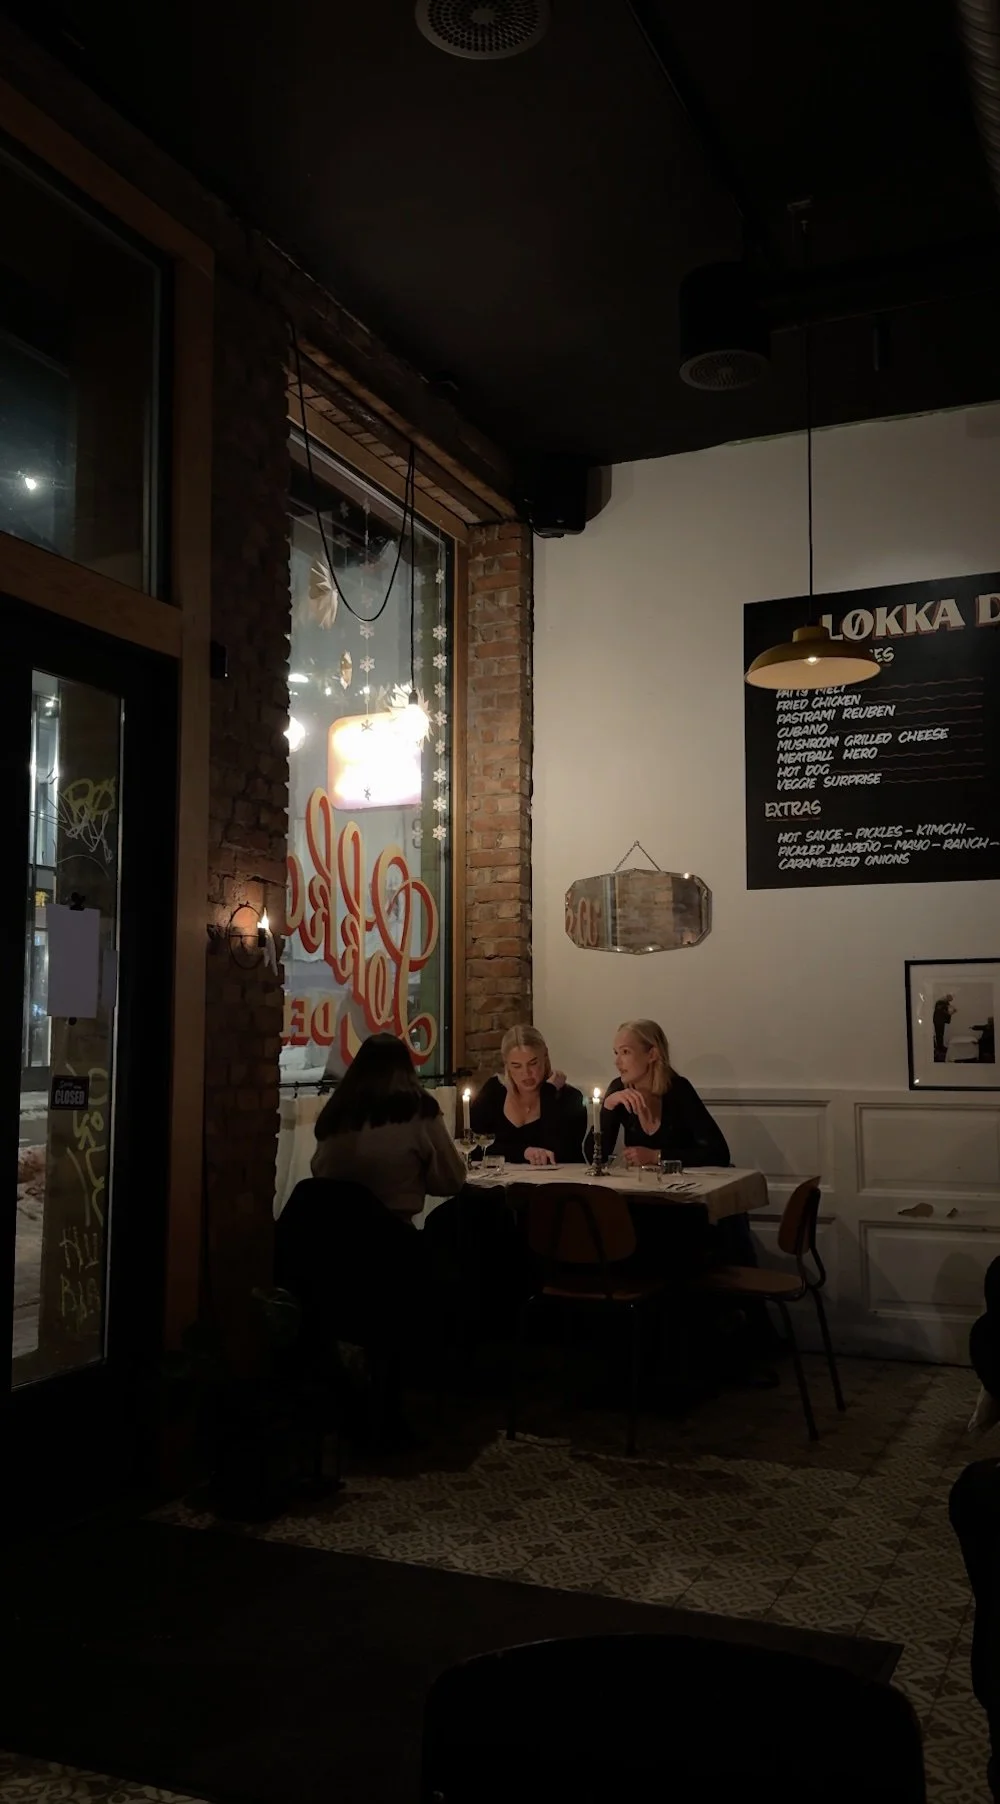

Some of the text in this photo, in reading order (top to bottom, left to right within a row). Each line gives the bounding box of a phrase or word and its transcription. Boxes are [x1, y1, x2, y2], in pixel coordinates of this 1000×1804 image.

[777, 694, 861, 711] FRIED CHICKEN
[777, 703, 896, 725] PASTRAMI REUBEN
[777, 723, 829, 739] CUBANO
[777, 728, 950, 751] MUSHROOM GRILLED CHEESE
[777, 746, 878, 764] MEATBALL HERO
[777, 763, 831, 778] HOT DOG
[777, 773, 883, 791] VEGGIE SURPRISE
[765, 800, 822, 818] EXTRAS
[778, 831, 802, 844] HOT
[805, 828, 844, 842] SAUCE
[855, 825, 904, 840] PICKLES
[916, 822, 967, 837] KIMCHI
[778, 844, 826, 857] PICKLED
[893, 839, 931, 851] MAYO
[942, 836, 990, 850] RANCH
[778, 852, 911, 871] CARAMELISED ONIONS
[54, 1088, 86, 1105] CLOSED
